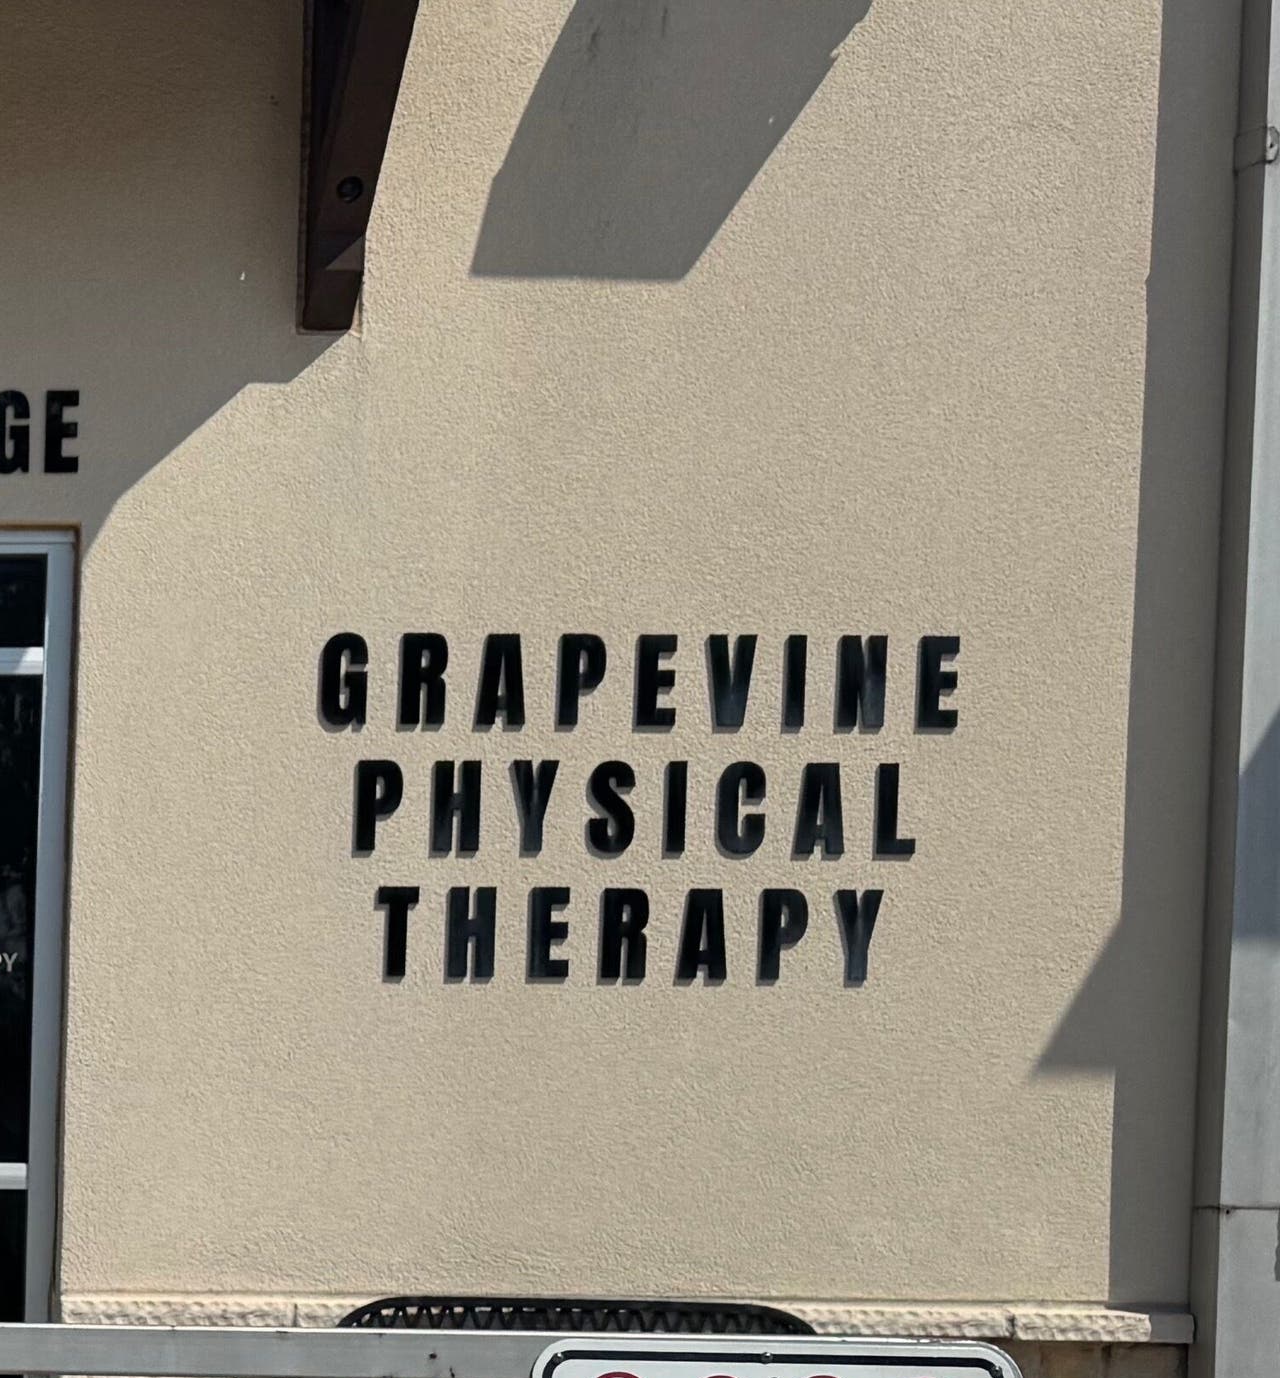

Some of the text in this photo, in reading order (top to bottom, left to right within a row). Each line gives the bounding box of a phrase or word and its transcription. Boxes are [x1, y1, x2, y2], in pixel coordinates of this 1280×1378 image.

[320, 632, 960, 729] GRAPEVINE
[355, 759, 916, 857] PHYSICAL
[377, 886, 884, 982] THERAPY
